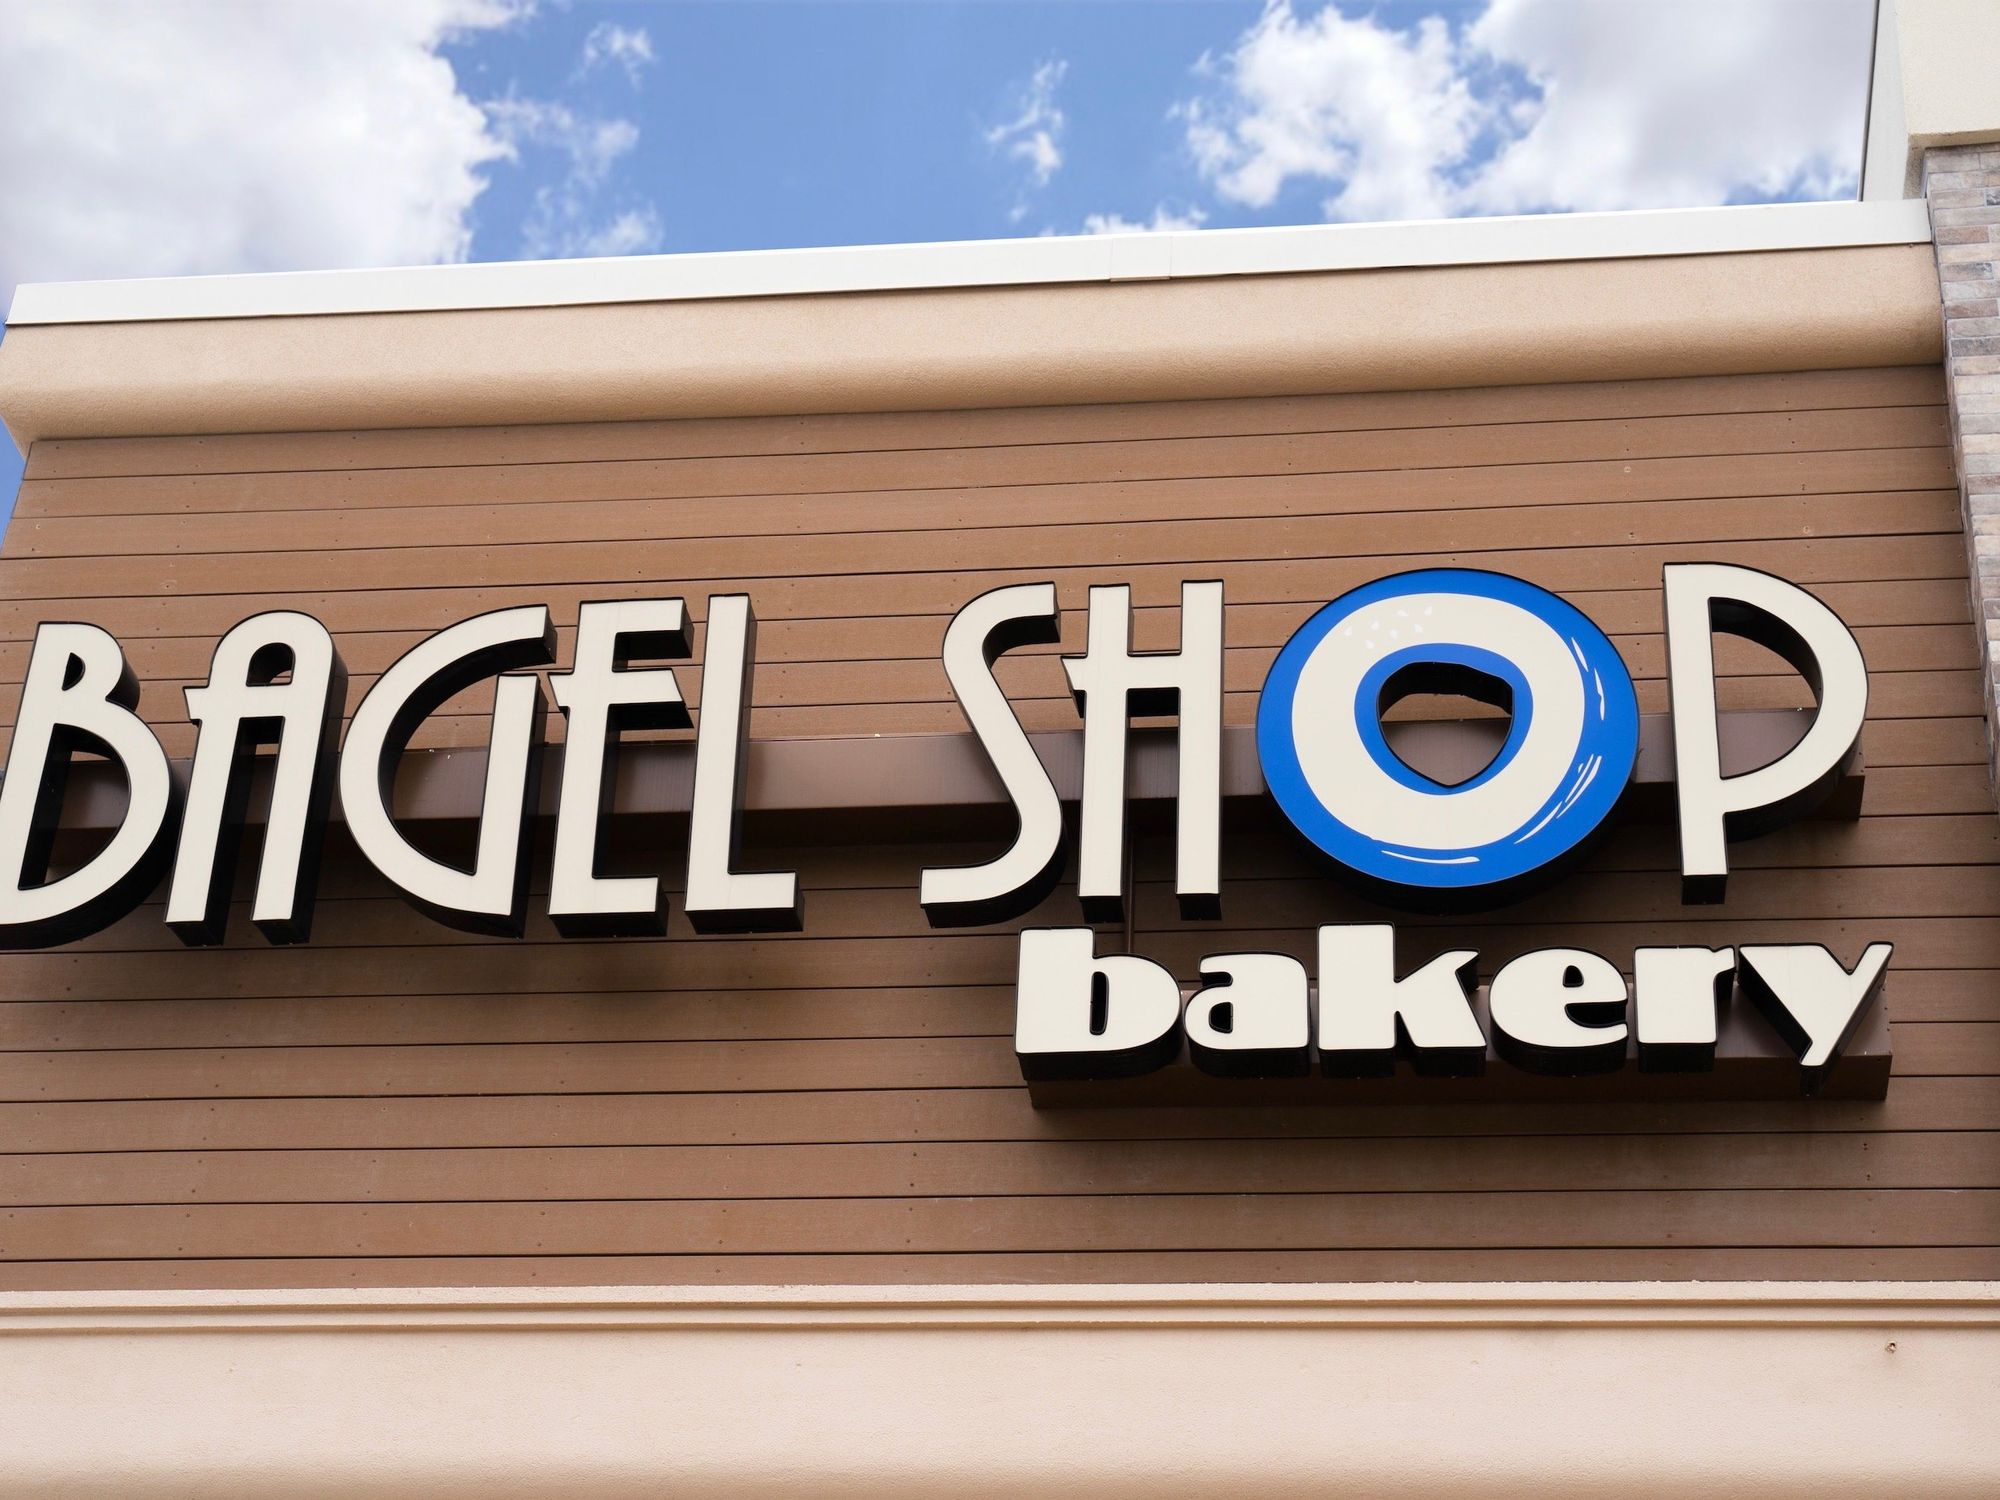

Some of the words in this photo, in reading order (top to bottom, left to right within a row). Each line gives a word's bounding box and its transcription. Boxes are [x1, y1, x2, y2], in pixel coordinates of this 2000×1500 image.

[0, 594, 798, 926] BAGEL
[919, 562, 1869, 906] SHOP
[1015, 922, 1893, 1069] bakery
